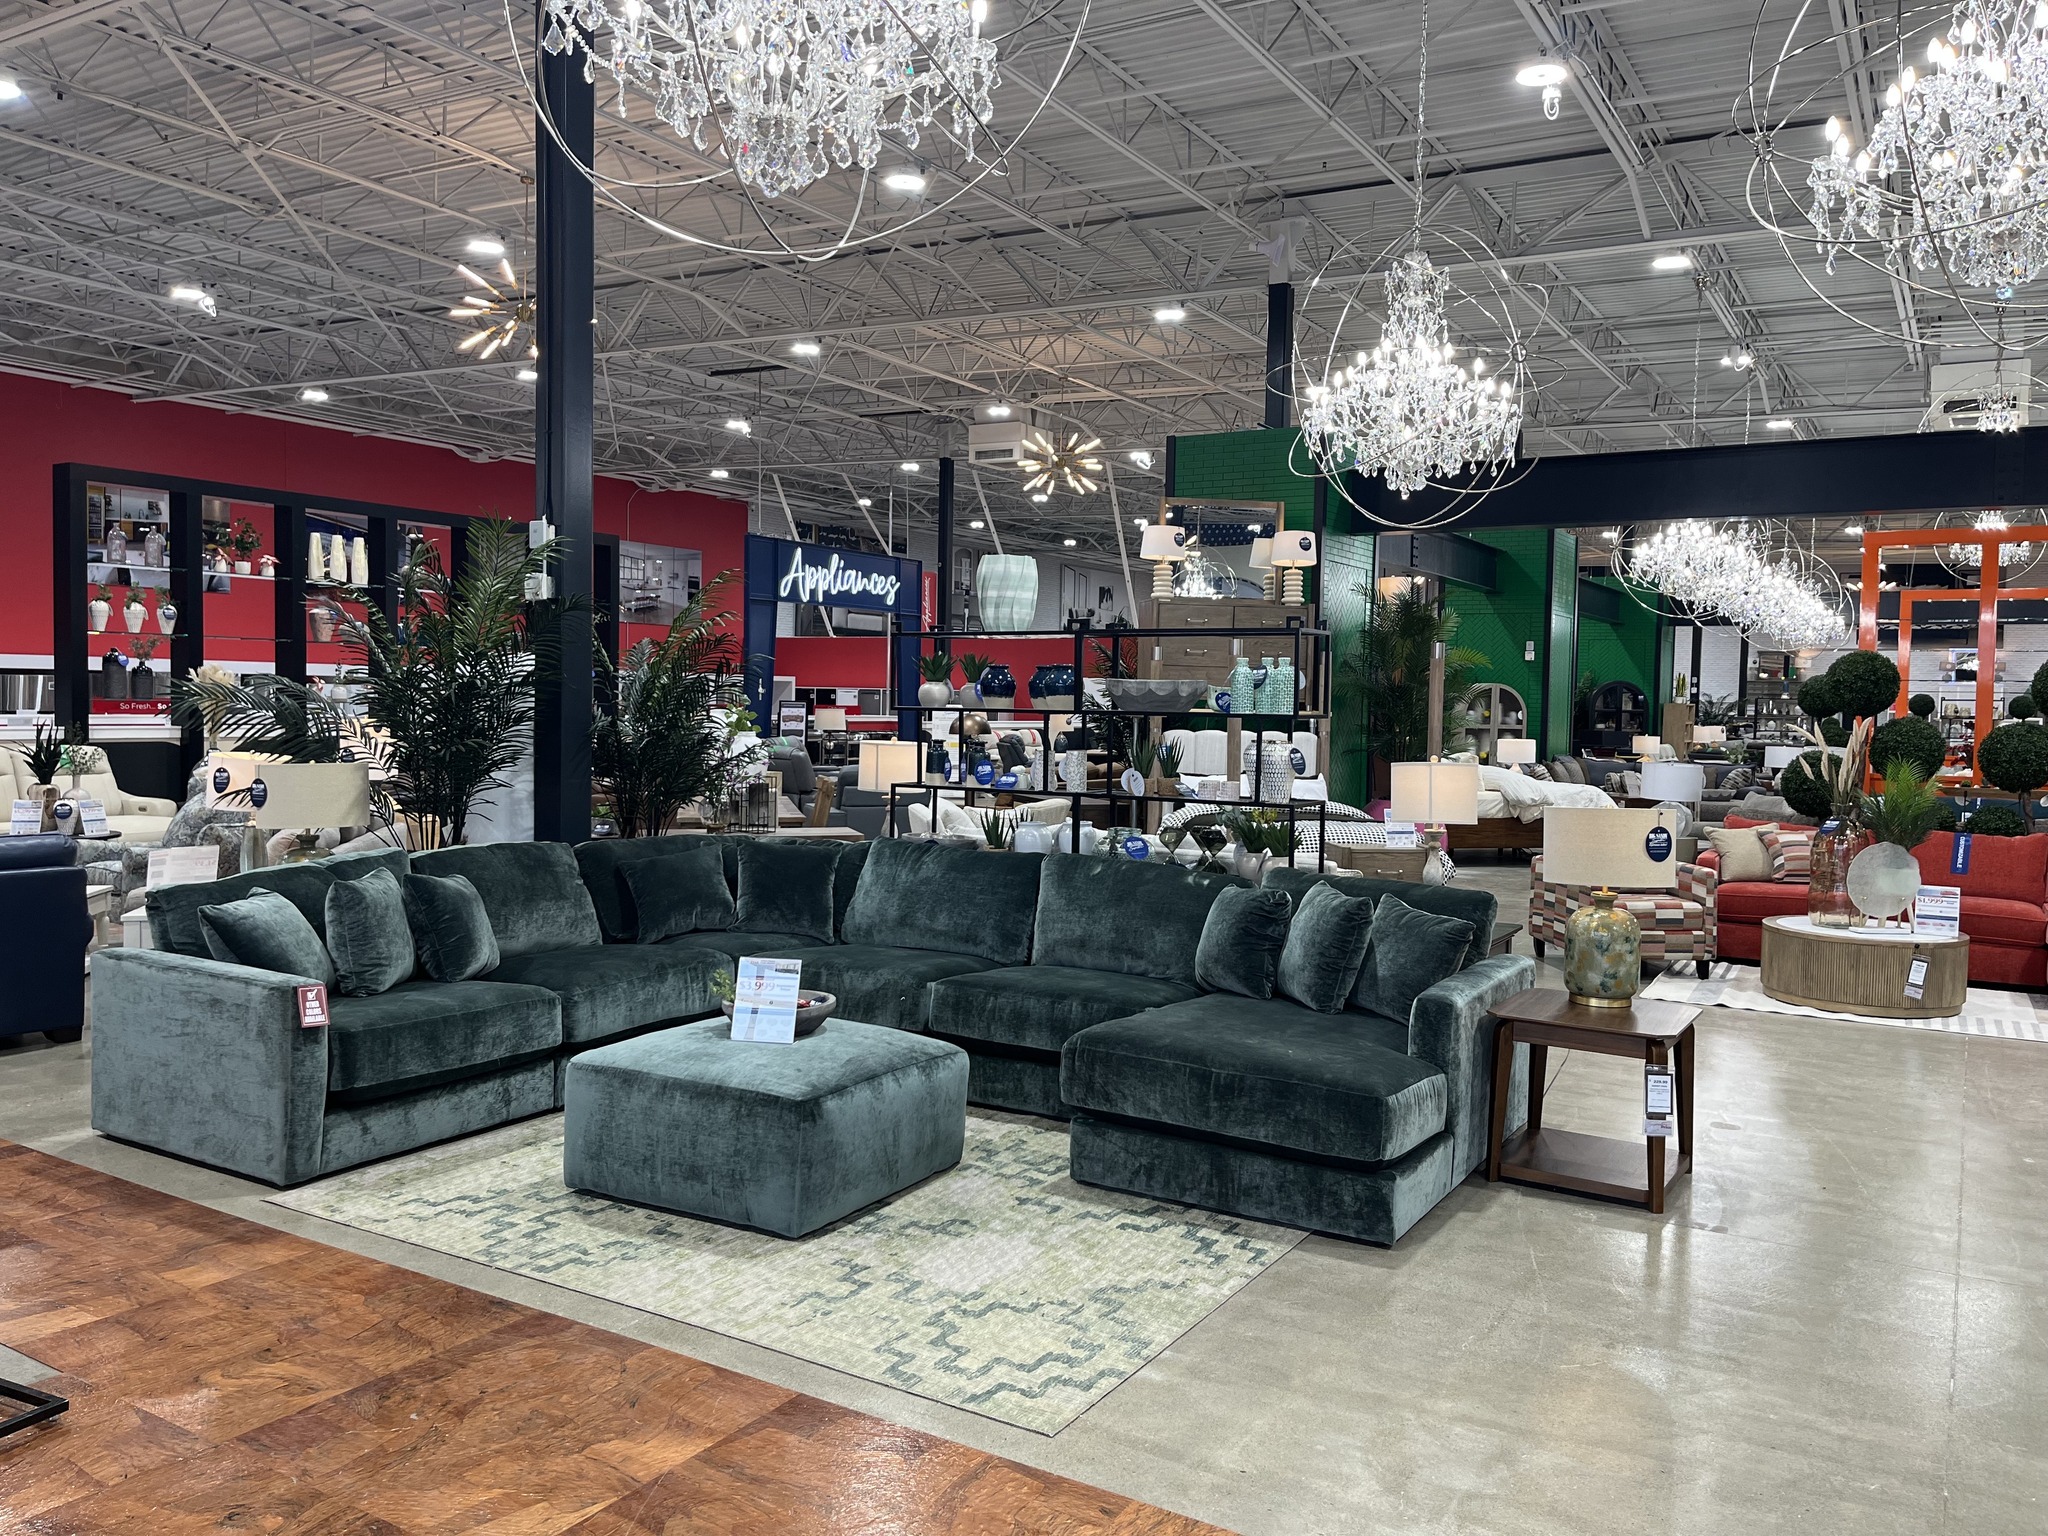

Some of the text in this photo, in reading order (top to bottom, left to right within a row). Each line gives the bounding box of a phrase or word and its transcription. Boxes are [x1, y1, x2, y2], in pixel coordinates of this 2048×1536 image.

[779, 546, 900, 606] Appliances
[921, 576, 932, 633] Appliances
[120, 702, 130, 710] So
[739, 980, 775, 992] $3,999
